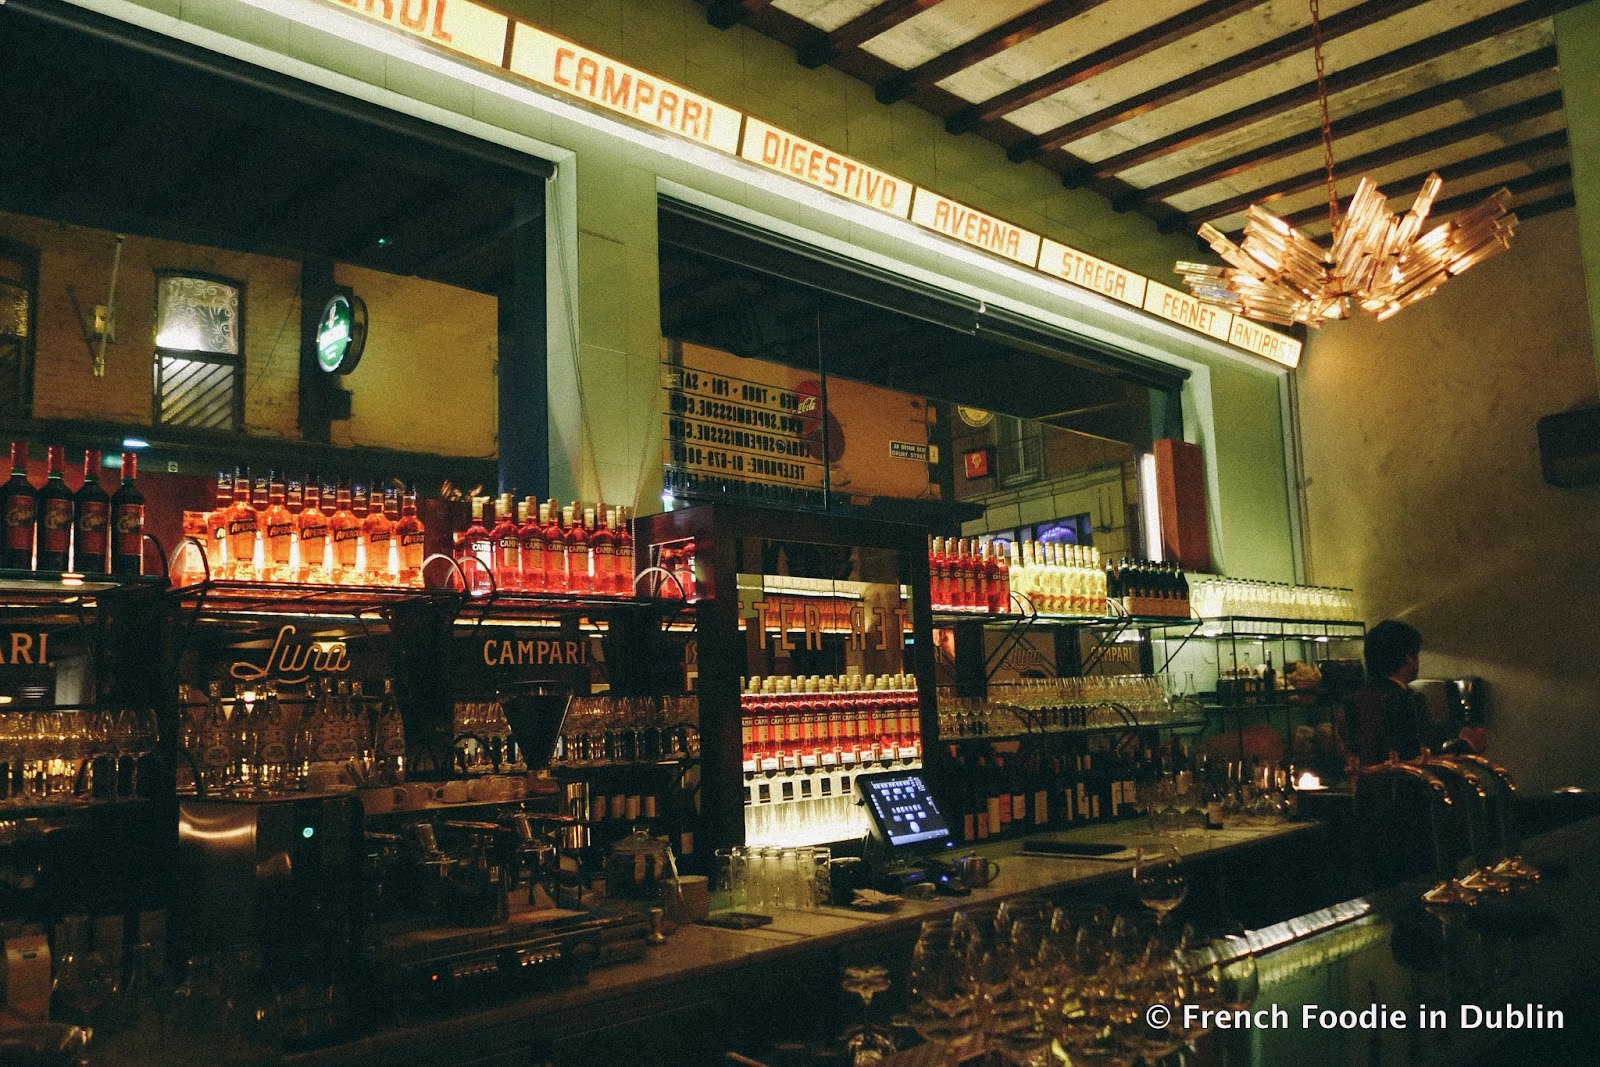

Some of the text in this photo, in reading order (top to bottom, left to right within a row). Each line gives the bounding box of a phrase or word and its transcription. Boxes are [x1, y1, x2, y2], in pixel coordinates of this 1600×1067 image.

[553, 47, 714, 141] CAMPARI
[761, 130, 897, 209] DIGESTIVO
[933, 200, 1021, 258] AVERNA
[1061, 252, 1127, 299] STREGA
[1161, 292, 1217, 332] FERNET
[230, 625, 351, 685] Luna
